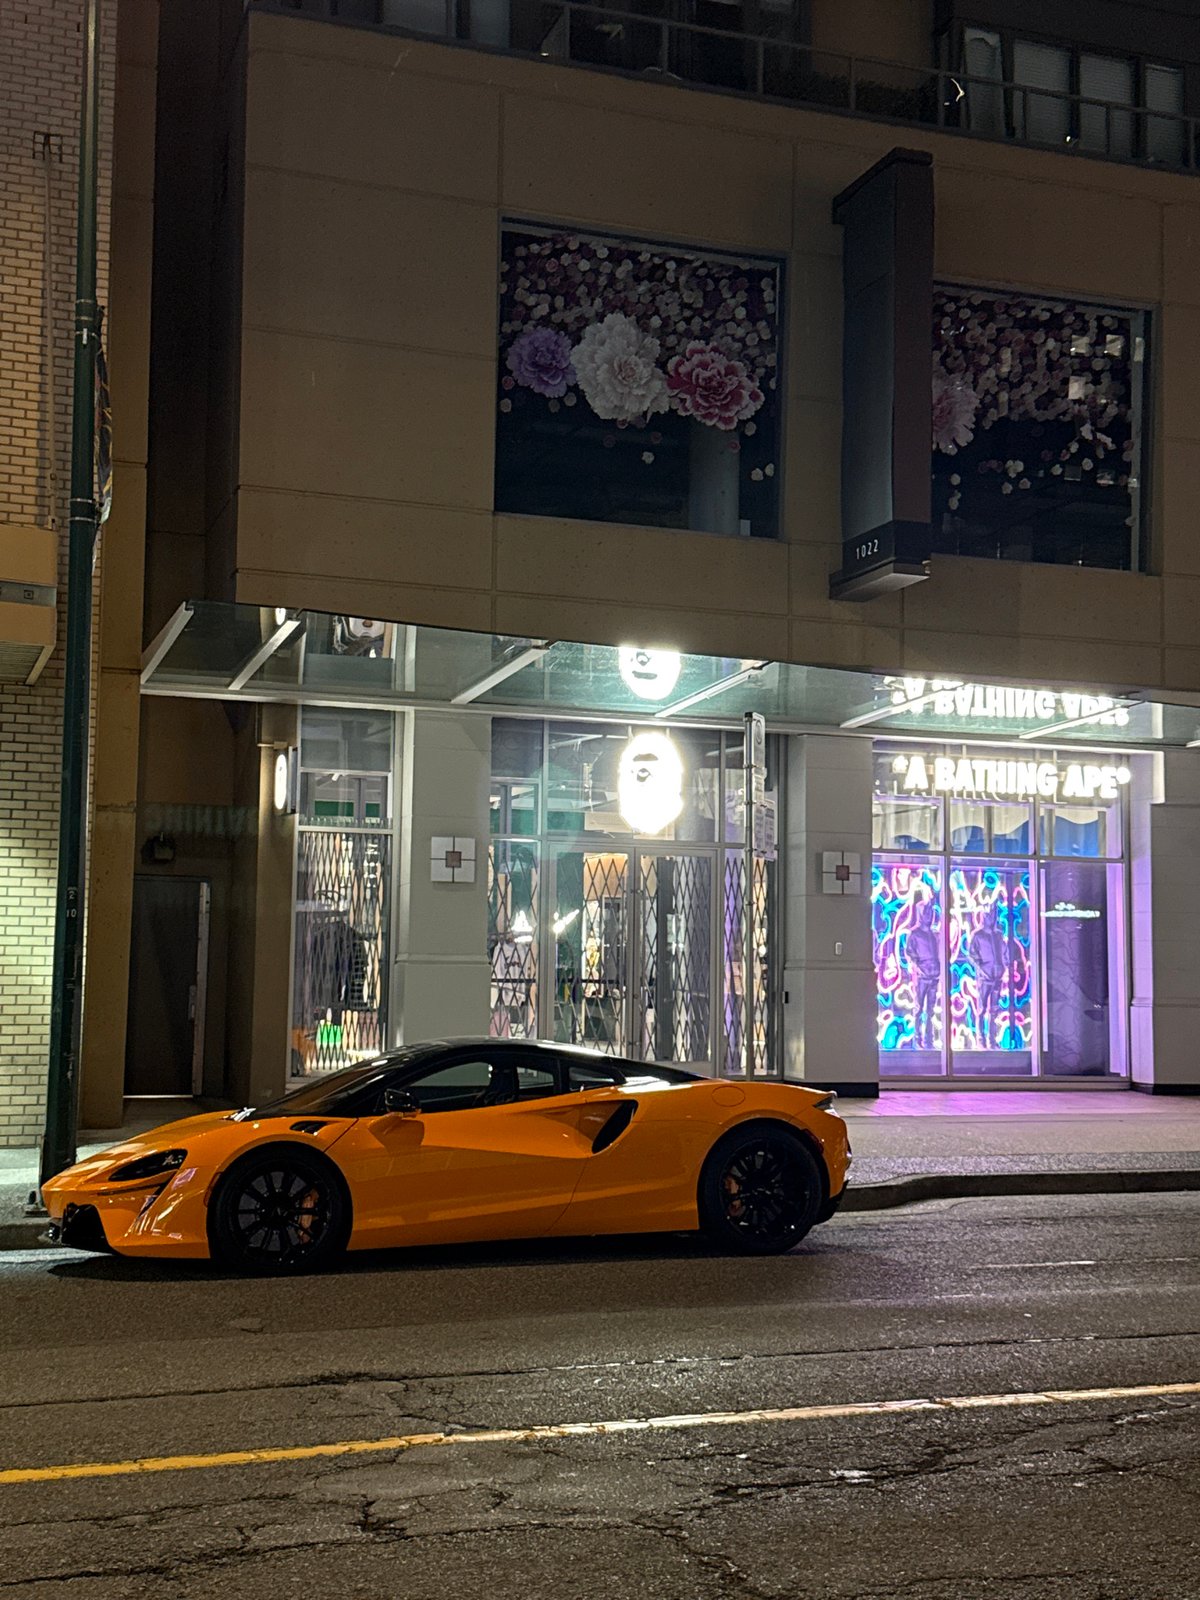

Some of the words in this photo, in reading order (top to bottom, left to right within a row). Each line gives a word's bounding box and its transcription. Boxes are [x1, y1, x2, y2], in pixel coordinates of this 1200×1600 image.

[856, 539, 879, 559] 1022
[904, 756, 929, 790] A
[934, 757, 1058, 796] BATHING
